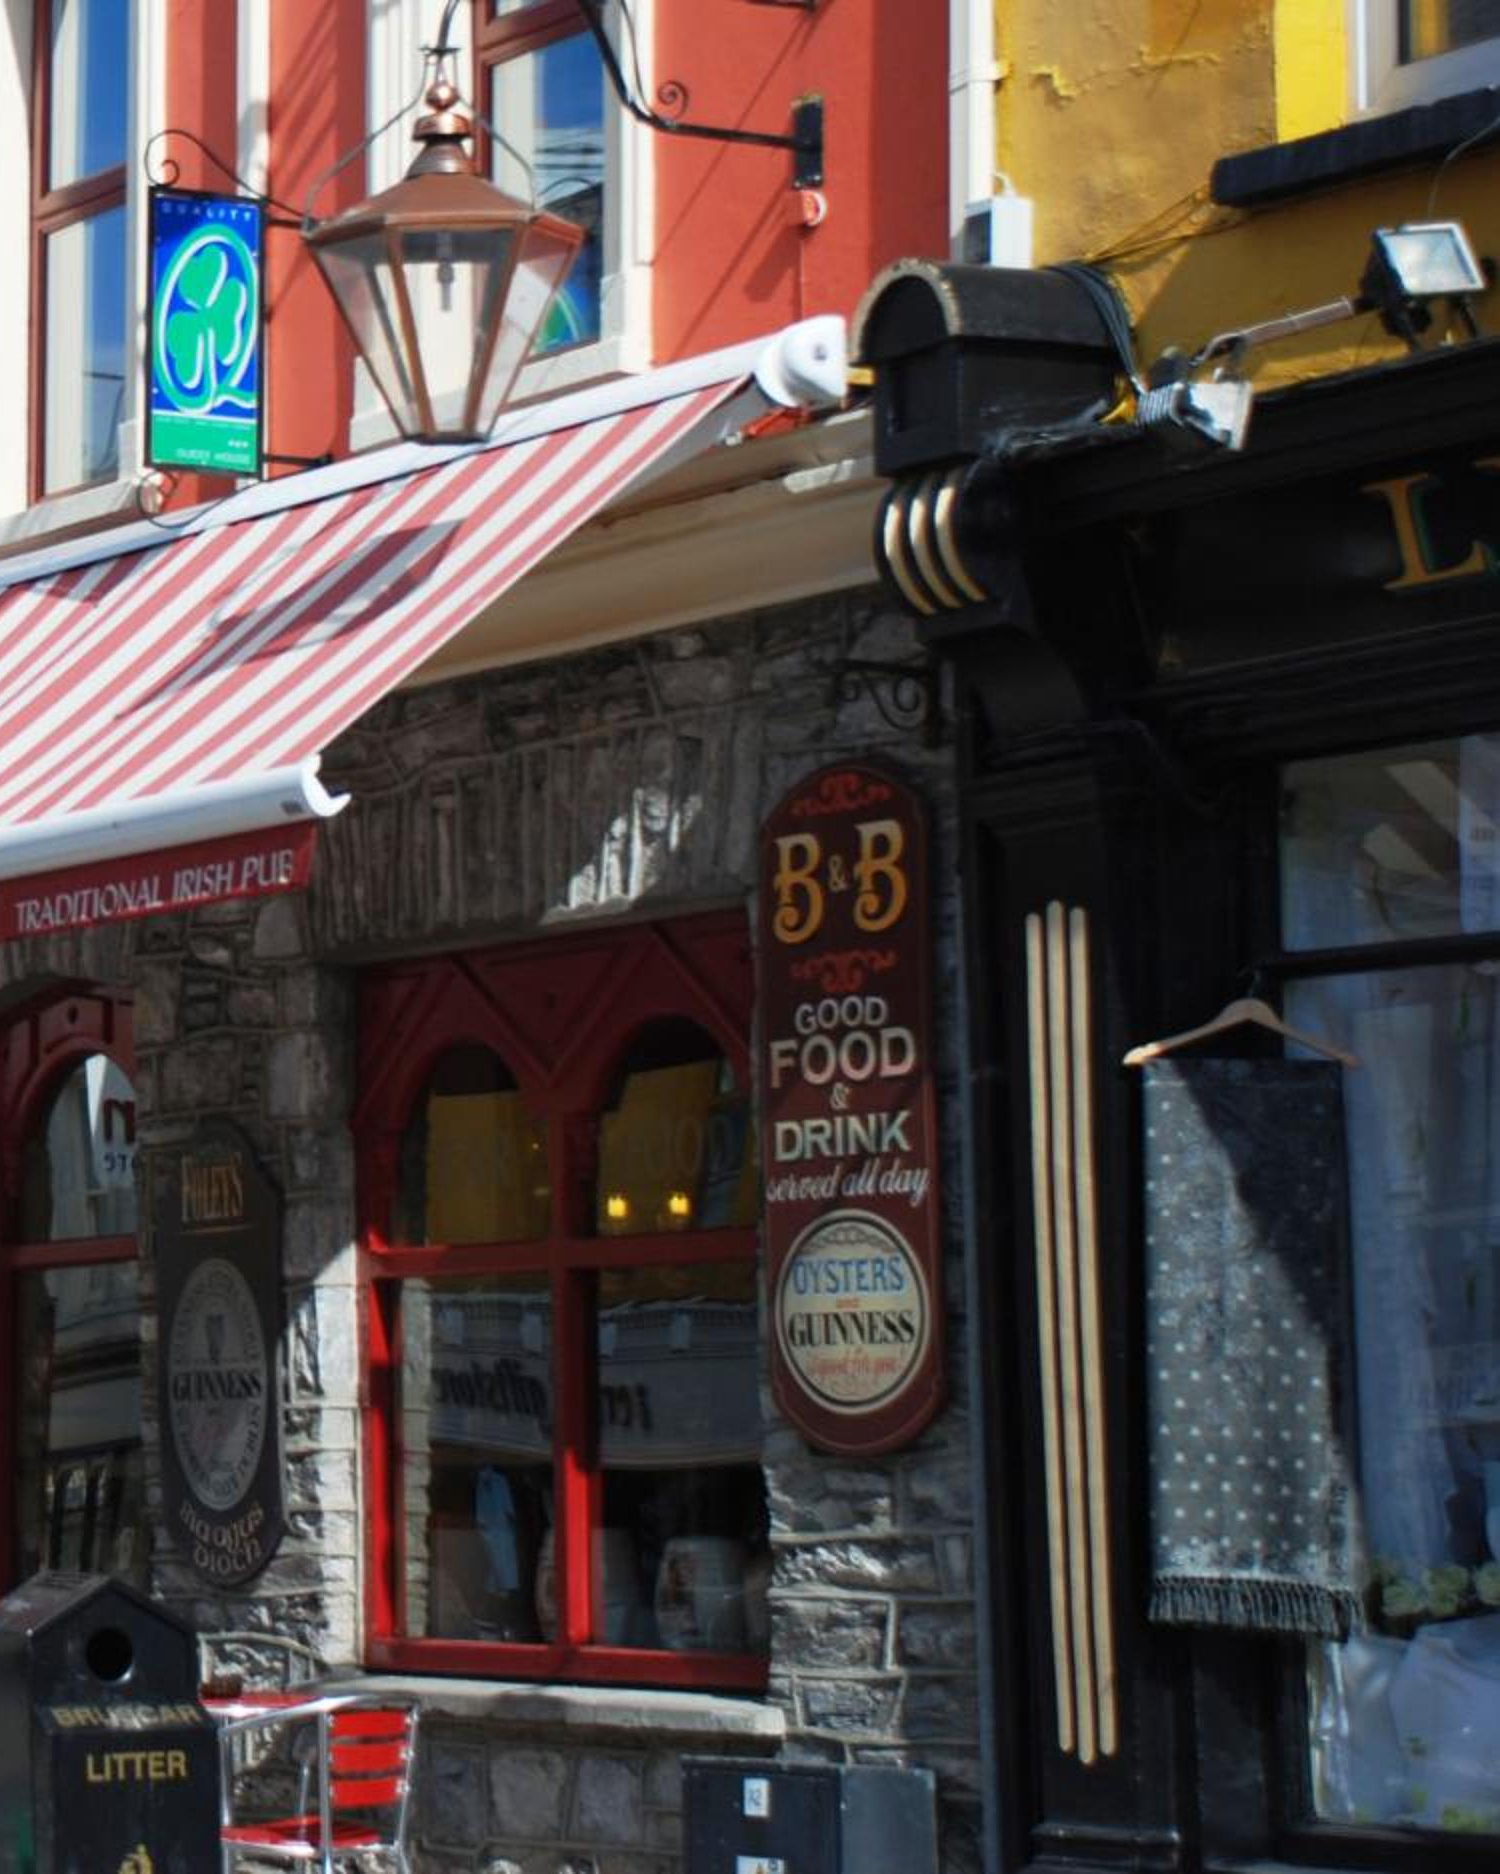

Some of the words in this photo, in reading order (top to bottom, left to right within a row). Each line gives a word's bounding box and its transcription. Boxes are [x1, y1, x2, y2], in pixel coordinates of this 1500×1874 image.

[1360, 456, 1500, 592] L
[15, 875, 164, 932] TRADITIONAL
[172, 861, 234, 902] IRISH
[240, 848, 293, 892] PUB
[795, 996, 888, 1034] GOOD
[769, 1026, 916, 1089] FOOD
[830, 1082, 850, 1109] &
[774, 1109, 912, 1161] DRINK
[766, 1164, 842, 1201] served
[842, 1157, 880, 1196] all
[880, 1157, 930, 1207] day
[793, 1253, 906, 1295] OYSTERS
[788, 1311, 915, 1346] GUINNESS
[173, 1371, 263, 1400] GUINNESS
[86, 1750, 188, 1783] LITTER
